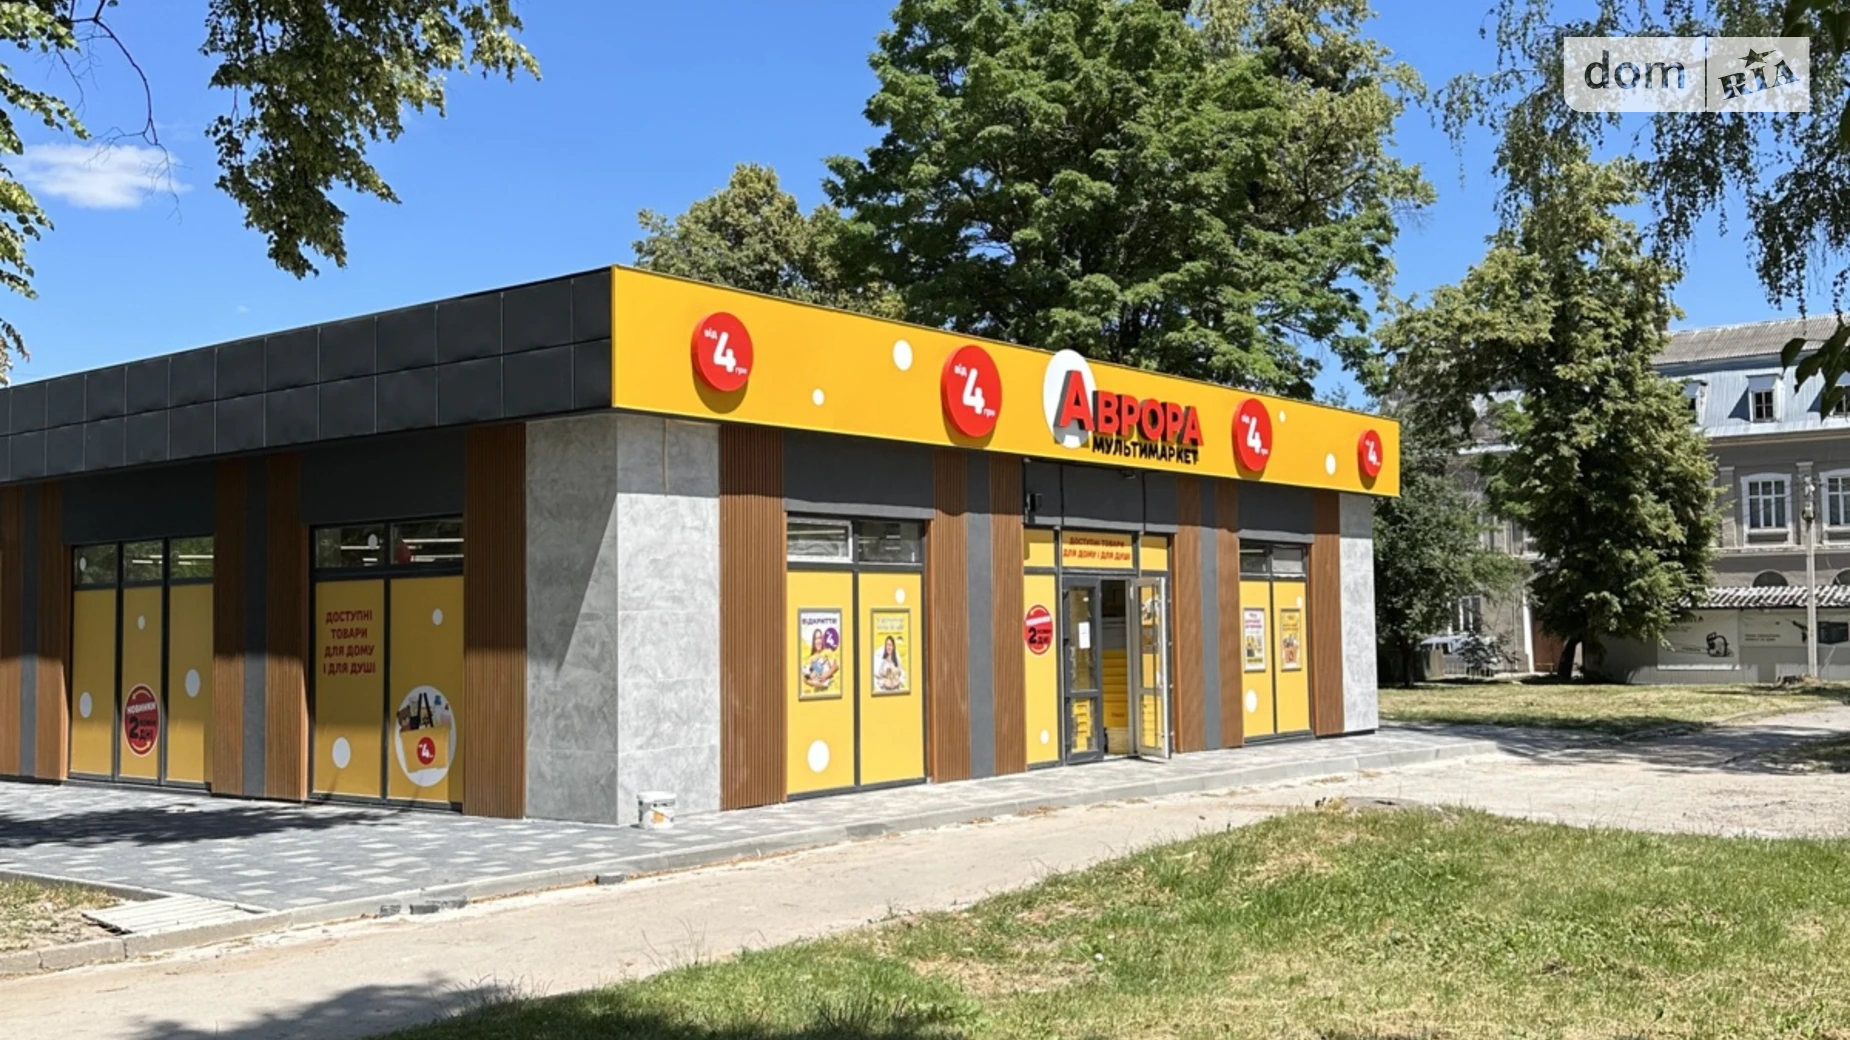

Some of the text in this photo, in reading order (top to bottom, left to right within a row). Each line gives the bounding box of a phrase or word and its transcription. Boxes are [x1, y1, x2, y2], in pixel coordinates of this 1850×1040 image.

[713, 331, 737, 373] 4
[962, 367, 986, 415] 4
[1053, 370, 1205, 447] АВРОРА
[1247, 416, 1262, 454] 4
[1092, 436, 1200, 465] МУЛЬТИМАРКЕТ
[1368, 440, 1378, 466] 4
[325, 609, 373, 625] ДОСТУПНІ
[331, 628, 368, 639] ТОВАРИ
[1028, 627, 1037, 644] 2
[324, 644, 375, 658] ДЛЯ ДОМУ
[327, 662, 348, 676] ДЛЯ
[350, 662, 376, 675] ДУШІ
[129, 715, 139, 738] 2
[421, 743, 431, 758] 4
